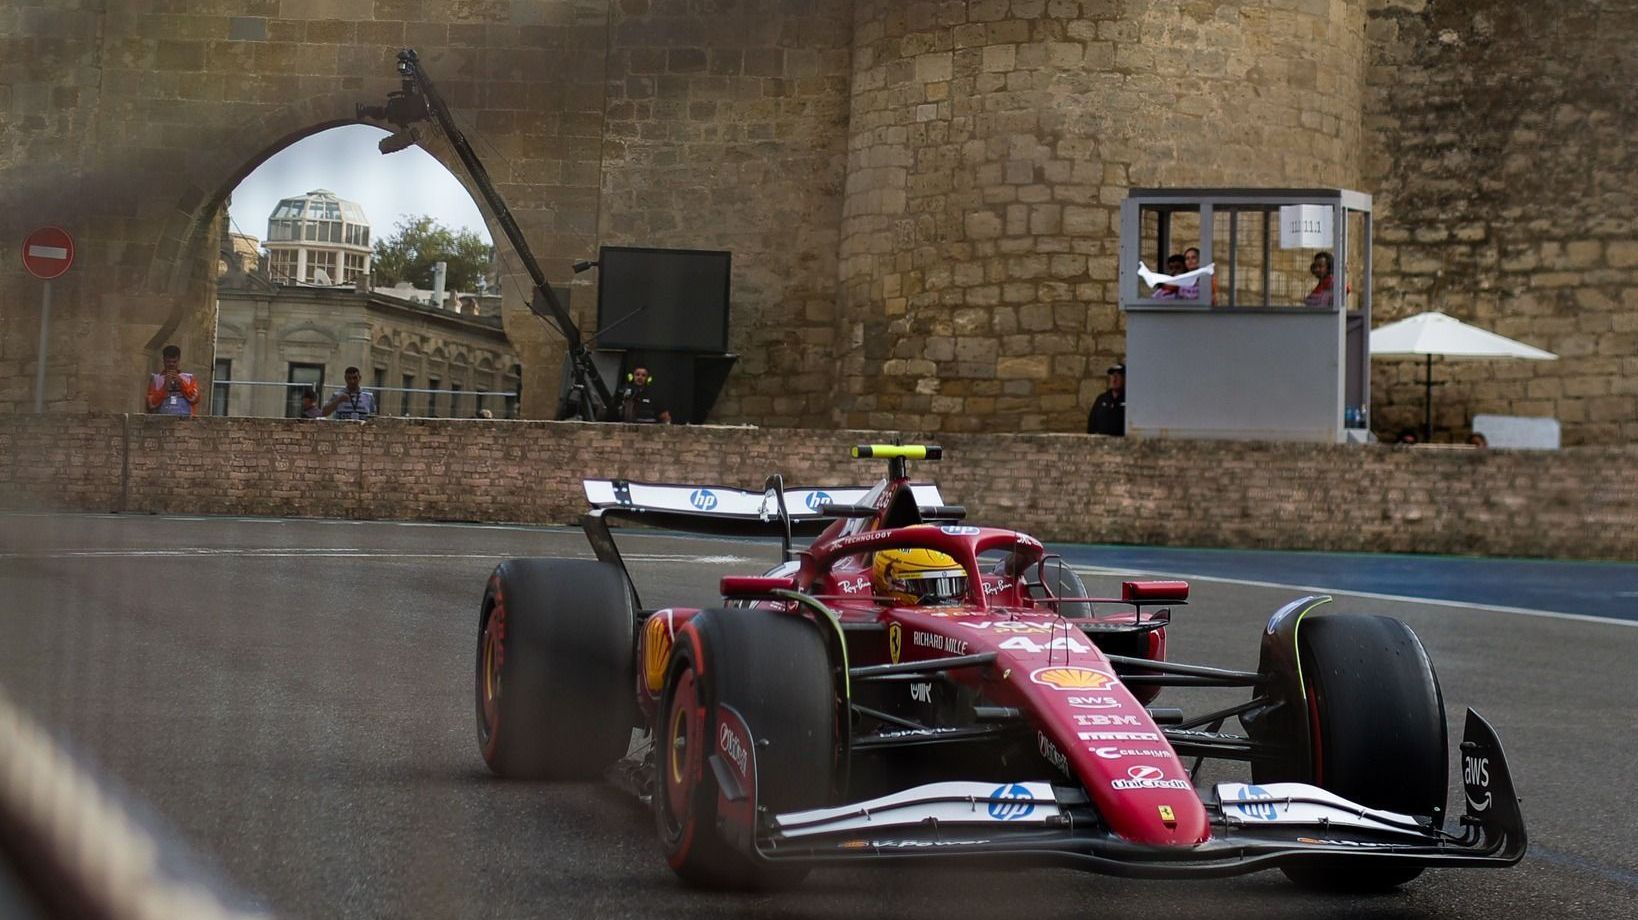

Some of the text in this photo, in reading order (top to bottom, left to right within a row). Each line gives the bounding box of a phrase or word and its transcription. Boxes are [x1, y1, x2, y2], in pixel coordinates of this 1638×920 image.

[692, 488, 716, 510] hp
[845, 532, 892, 544] TECHNOLOGY
[913, 631, 969, 656] RICHARD MILLE
[998, 636, 1091, 654] 44
[1067, 696, 1119, 705] aws
[1073, 714, 1142, 726] IBM
[1464, 756, 1490, 787] aws
[1111, 779, 1192, 790] UniCredit
[992, 783, 1031, 821] hp
